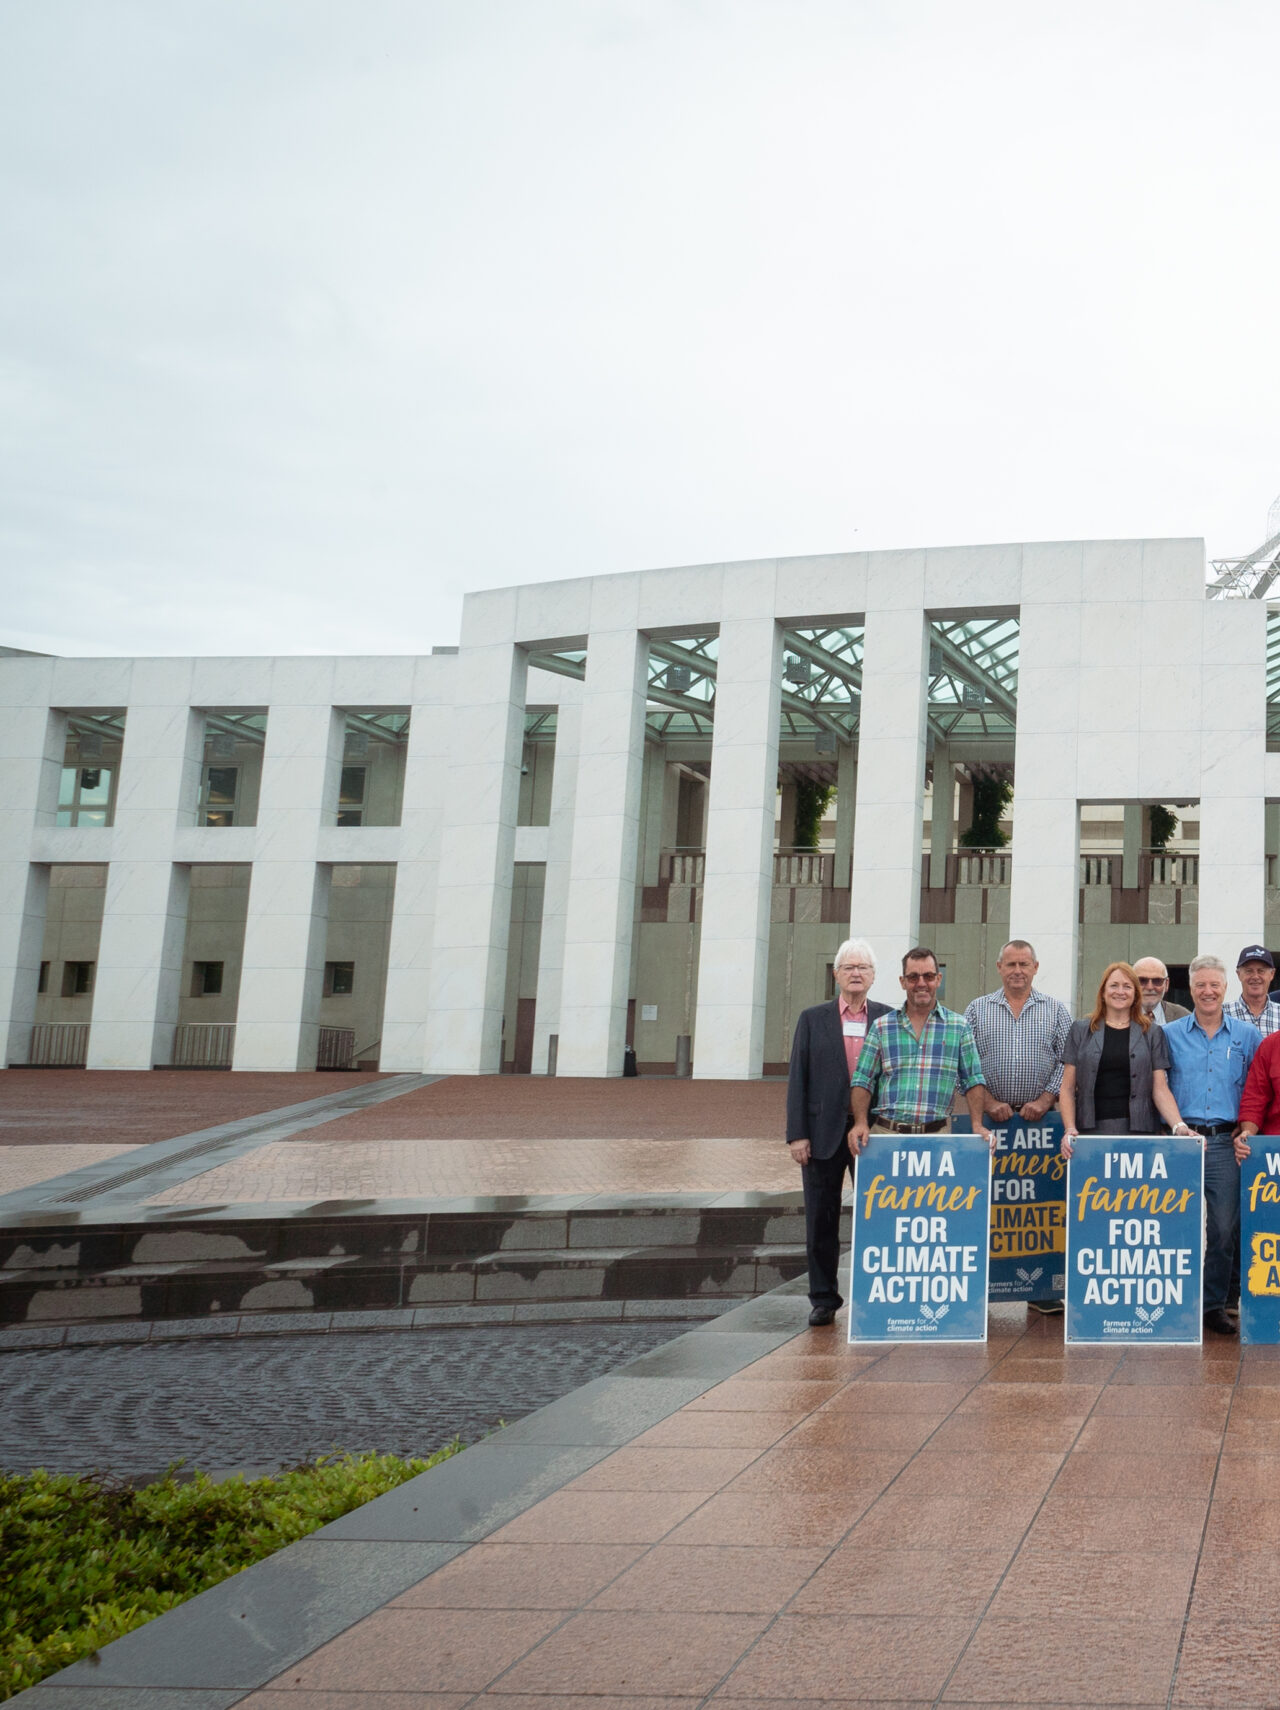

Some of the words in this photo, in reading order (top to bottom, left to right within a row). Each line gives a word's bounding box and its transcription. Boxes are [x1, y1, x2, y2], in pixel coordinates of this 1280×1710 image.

[1012, 1128, 1054, 1149] ARE
[892, 1151, 931, 1177] I'M
[937, 1151, 956, 1177] A
[1104, 1153, 1143, 1179] I'M
[1150, 1153, 1168, 1179] A
[864, 1174, 982, 1220] farmer
[993, 1179, 1036, 1201] FOR
[1076, 1176, 1195, 1222] farmer
[895, 1216, 948, 1243] FOR
[990, 1230, 1054, 1253] CTION
[1109, 1219, 1161, 1246] FOR
[862, 1246, 978, 1274] CLIMATE
[1077, 1248, 1192, 1275] CLIMATE
[868, 1275, 969, 1303] ACTION
[1083, 1278, 1183, 1305] ACTION
[1131, 1326, 1153, 1334] action
